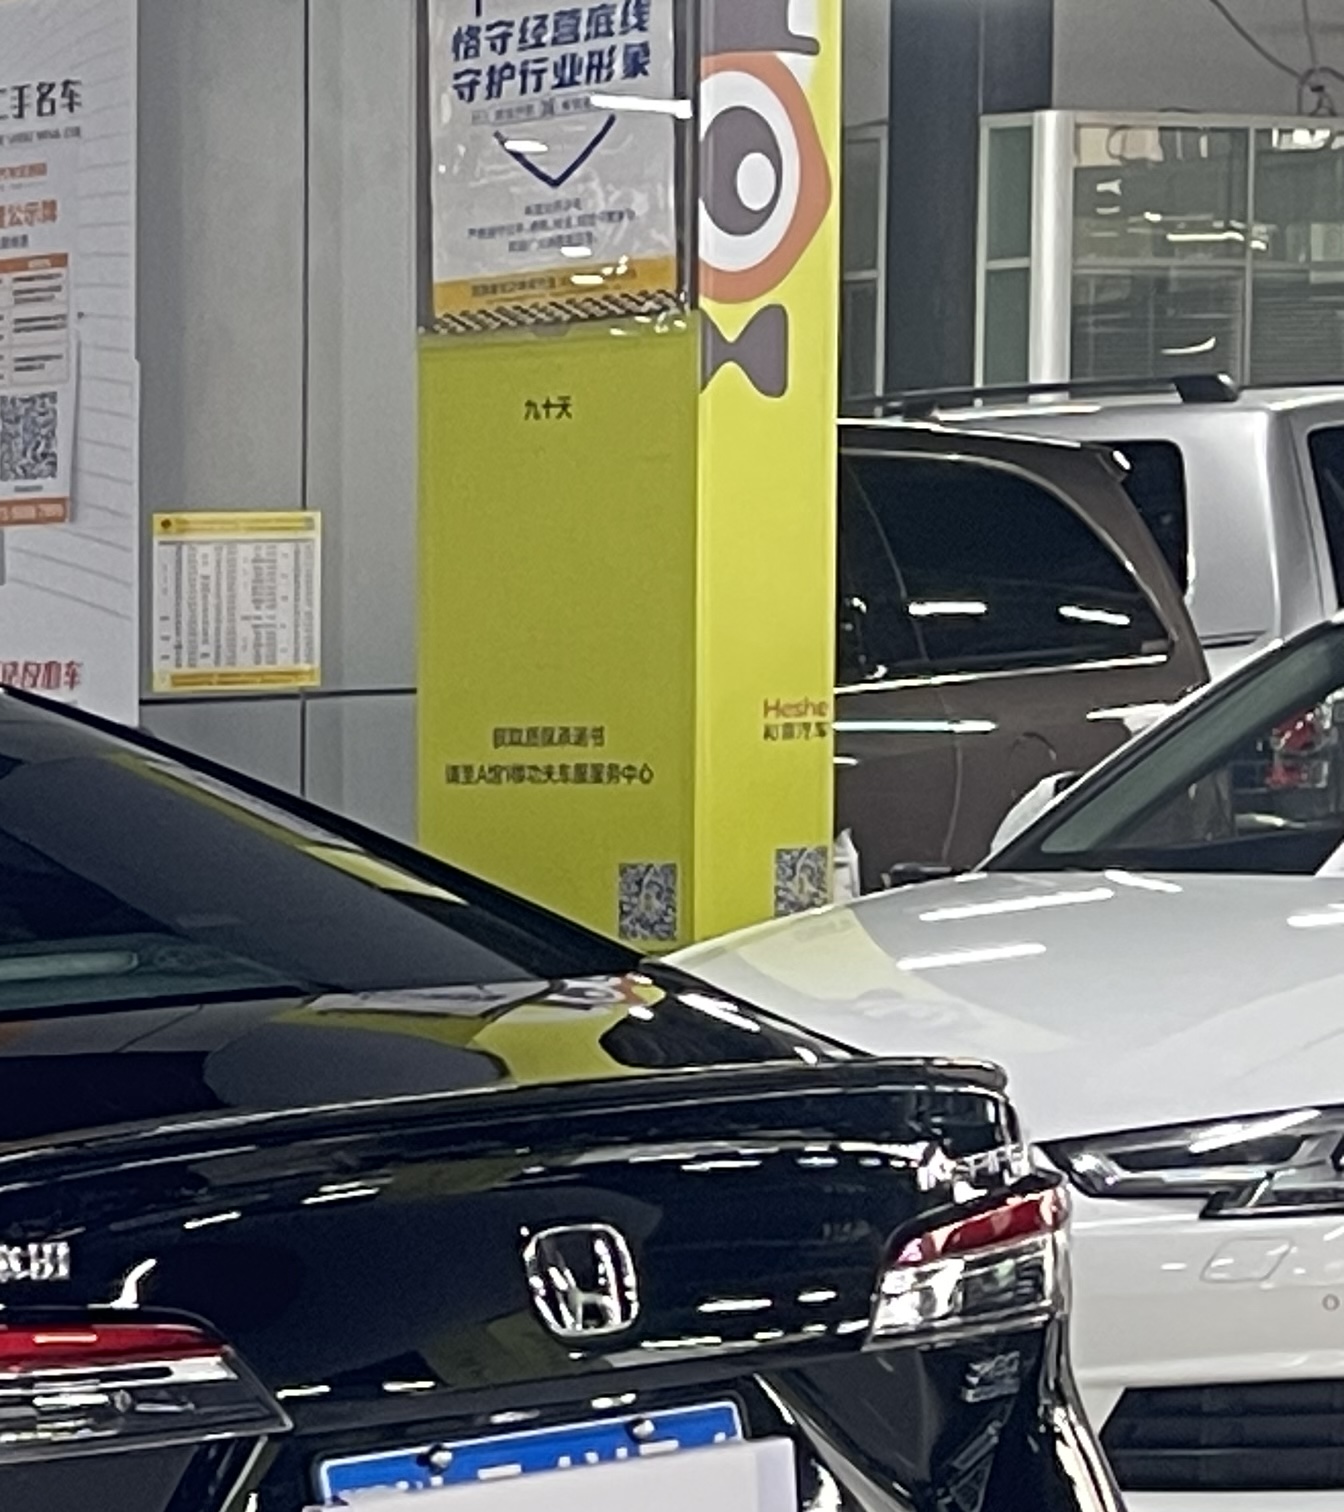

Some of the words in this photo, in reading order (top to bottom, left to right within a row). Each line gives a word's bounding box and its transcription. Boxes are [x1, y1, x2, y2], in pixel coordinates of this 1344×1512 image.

[451, 0, 652, 62] 恪守经营底线
[452, 40, 652, 103] 守护行业形象
[524, 395, 573, 421] 九十天
